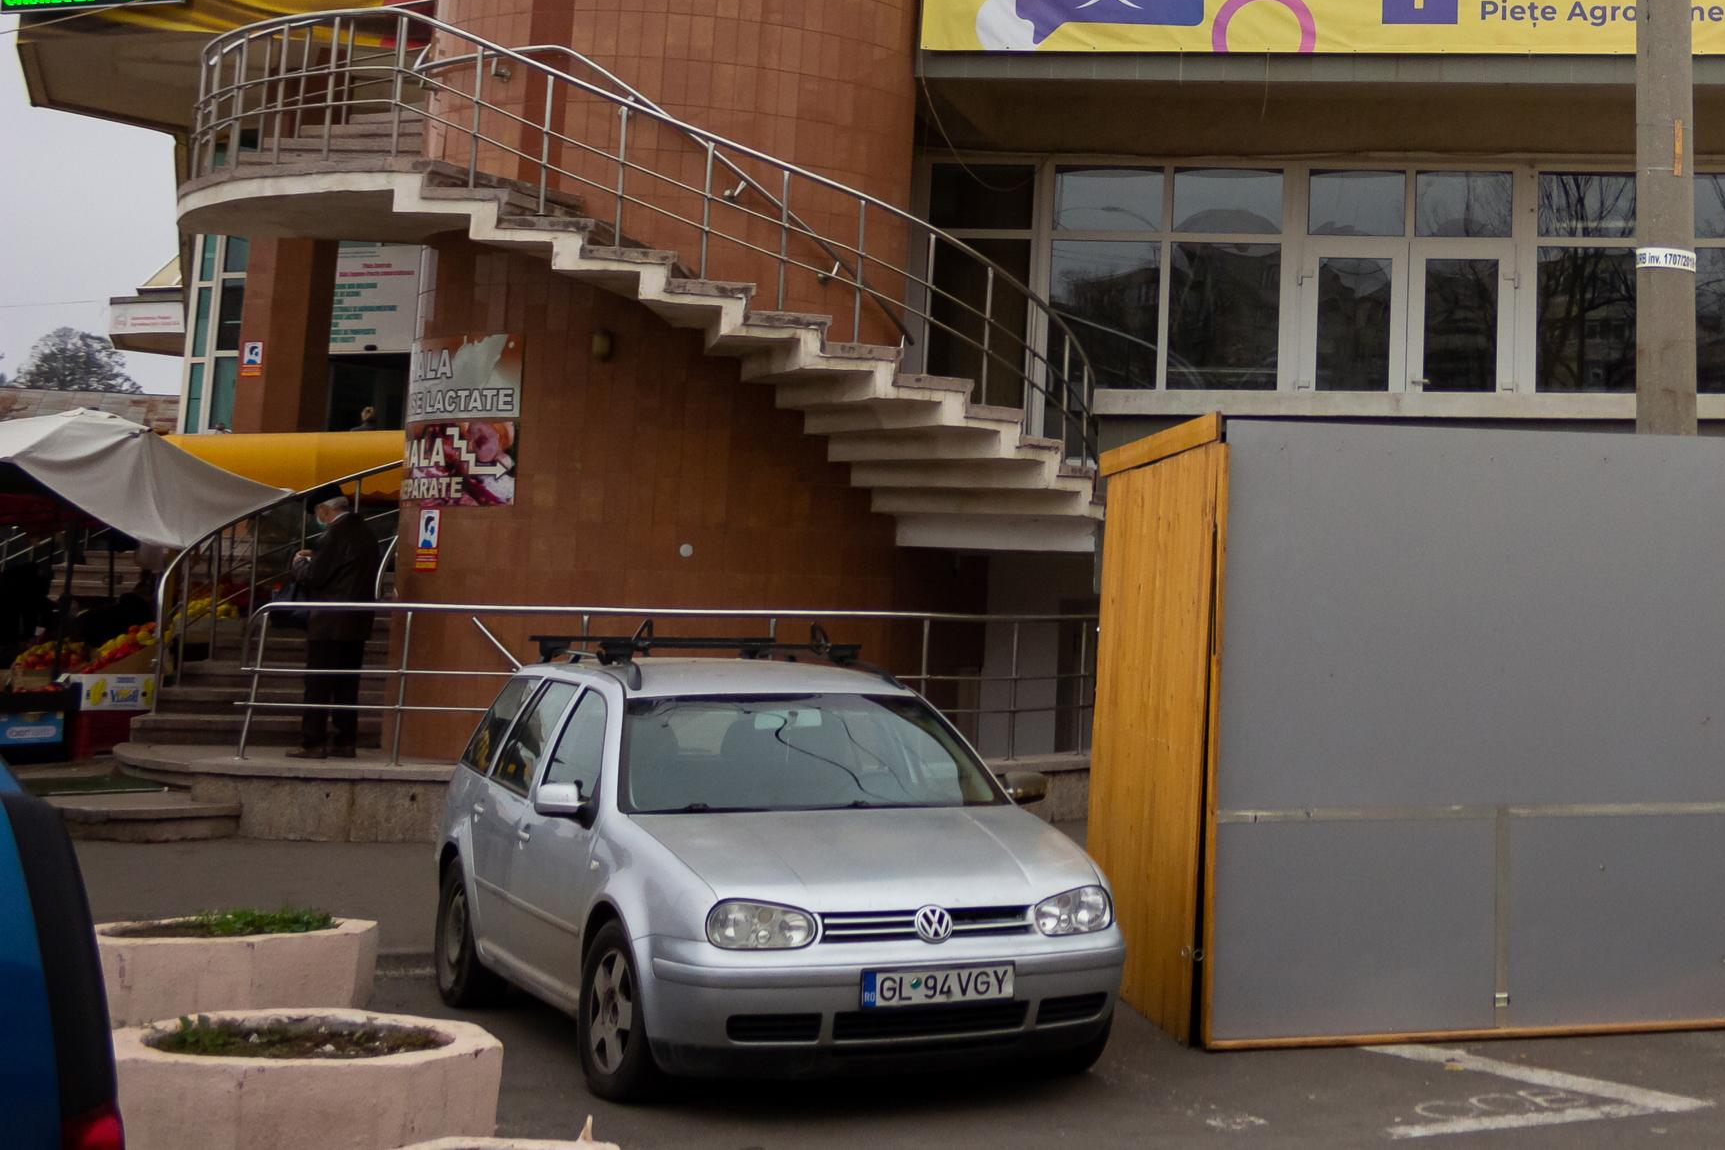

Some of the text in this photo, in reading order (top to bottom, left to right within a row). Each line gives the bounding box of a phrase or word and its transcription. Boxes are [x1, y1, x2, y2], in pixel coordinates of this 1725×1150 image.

[1480, 0, 1557, 30] Piețe
[1648, 252, 1661, 266] inv.
[425, 387, 515, 415] LACTATE
[406, 437, 447, 469] ALA
[864, 968, 1010, 1004] RO GL 94 VGY
